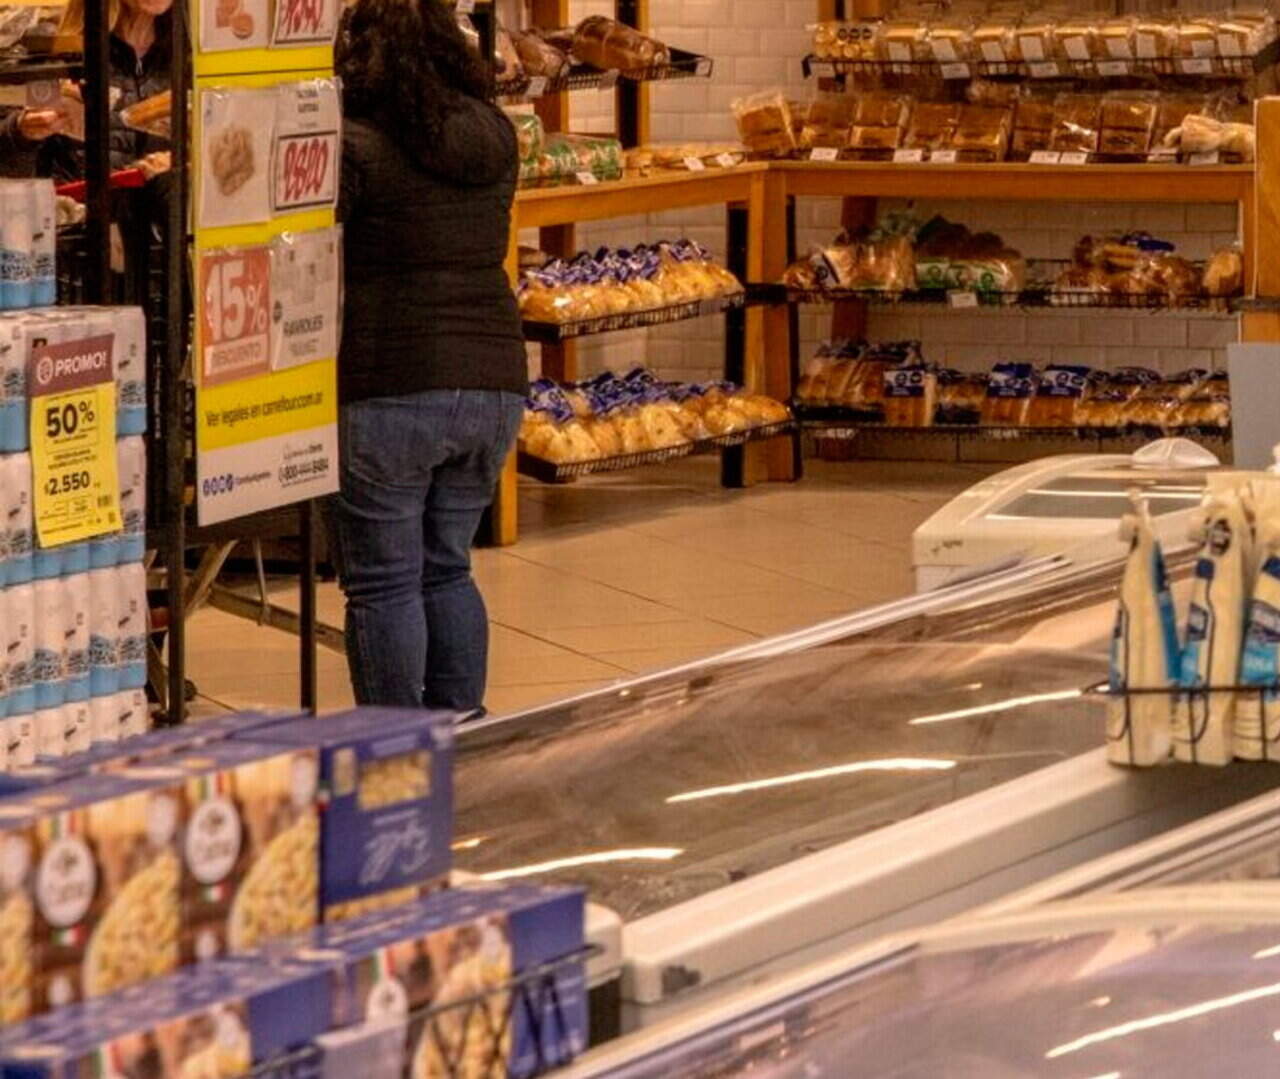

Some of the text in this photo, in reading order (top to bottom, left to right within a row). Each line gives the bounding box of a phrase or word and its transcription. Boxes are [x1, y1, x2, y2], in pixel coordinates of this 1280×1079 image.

[205, 258, 268, 340] 15%
[55, 351, 107, 377] PROMO!
[46, 400, 95, 438] 50%
